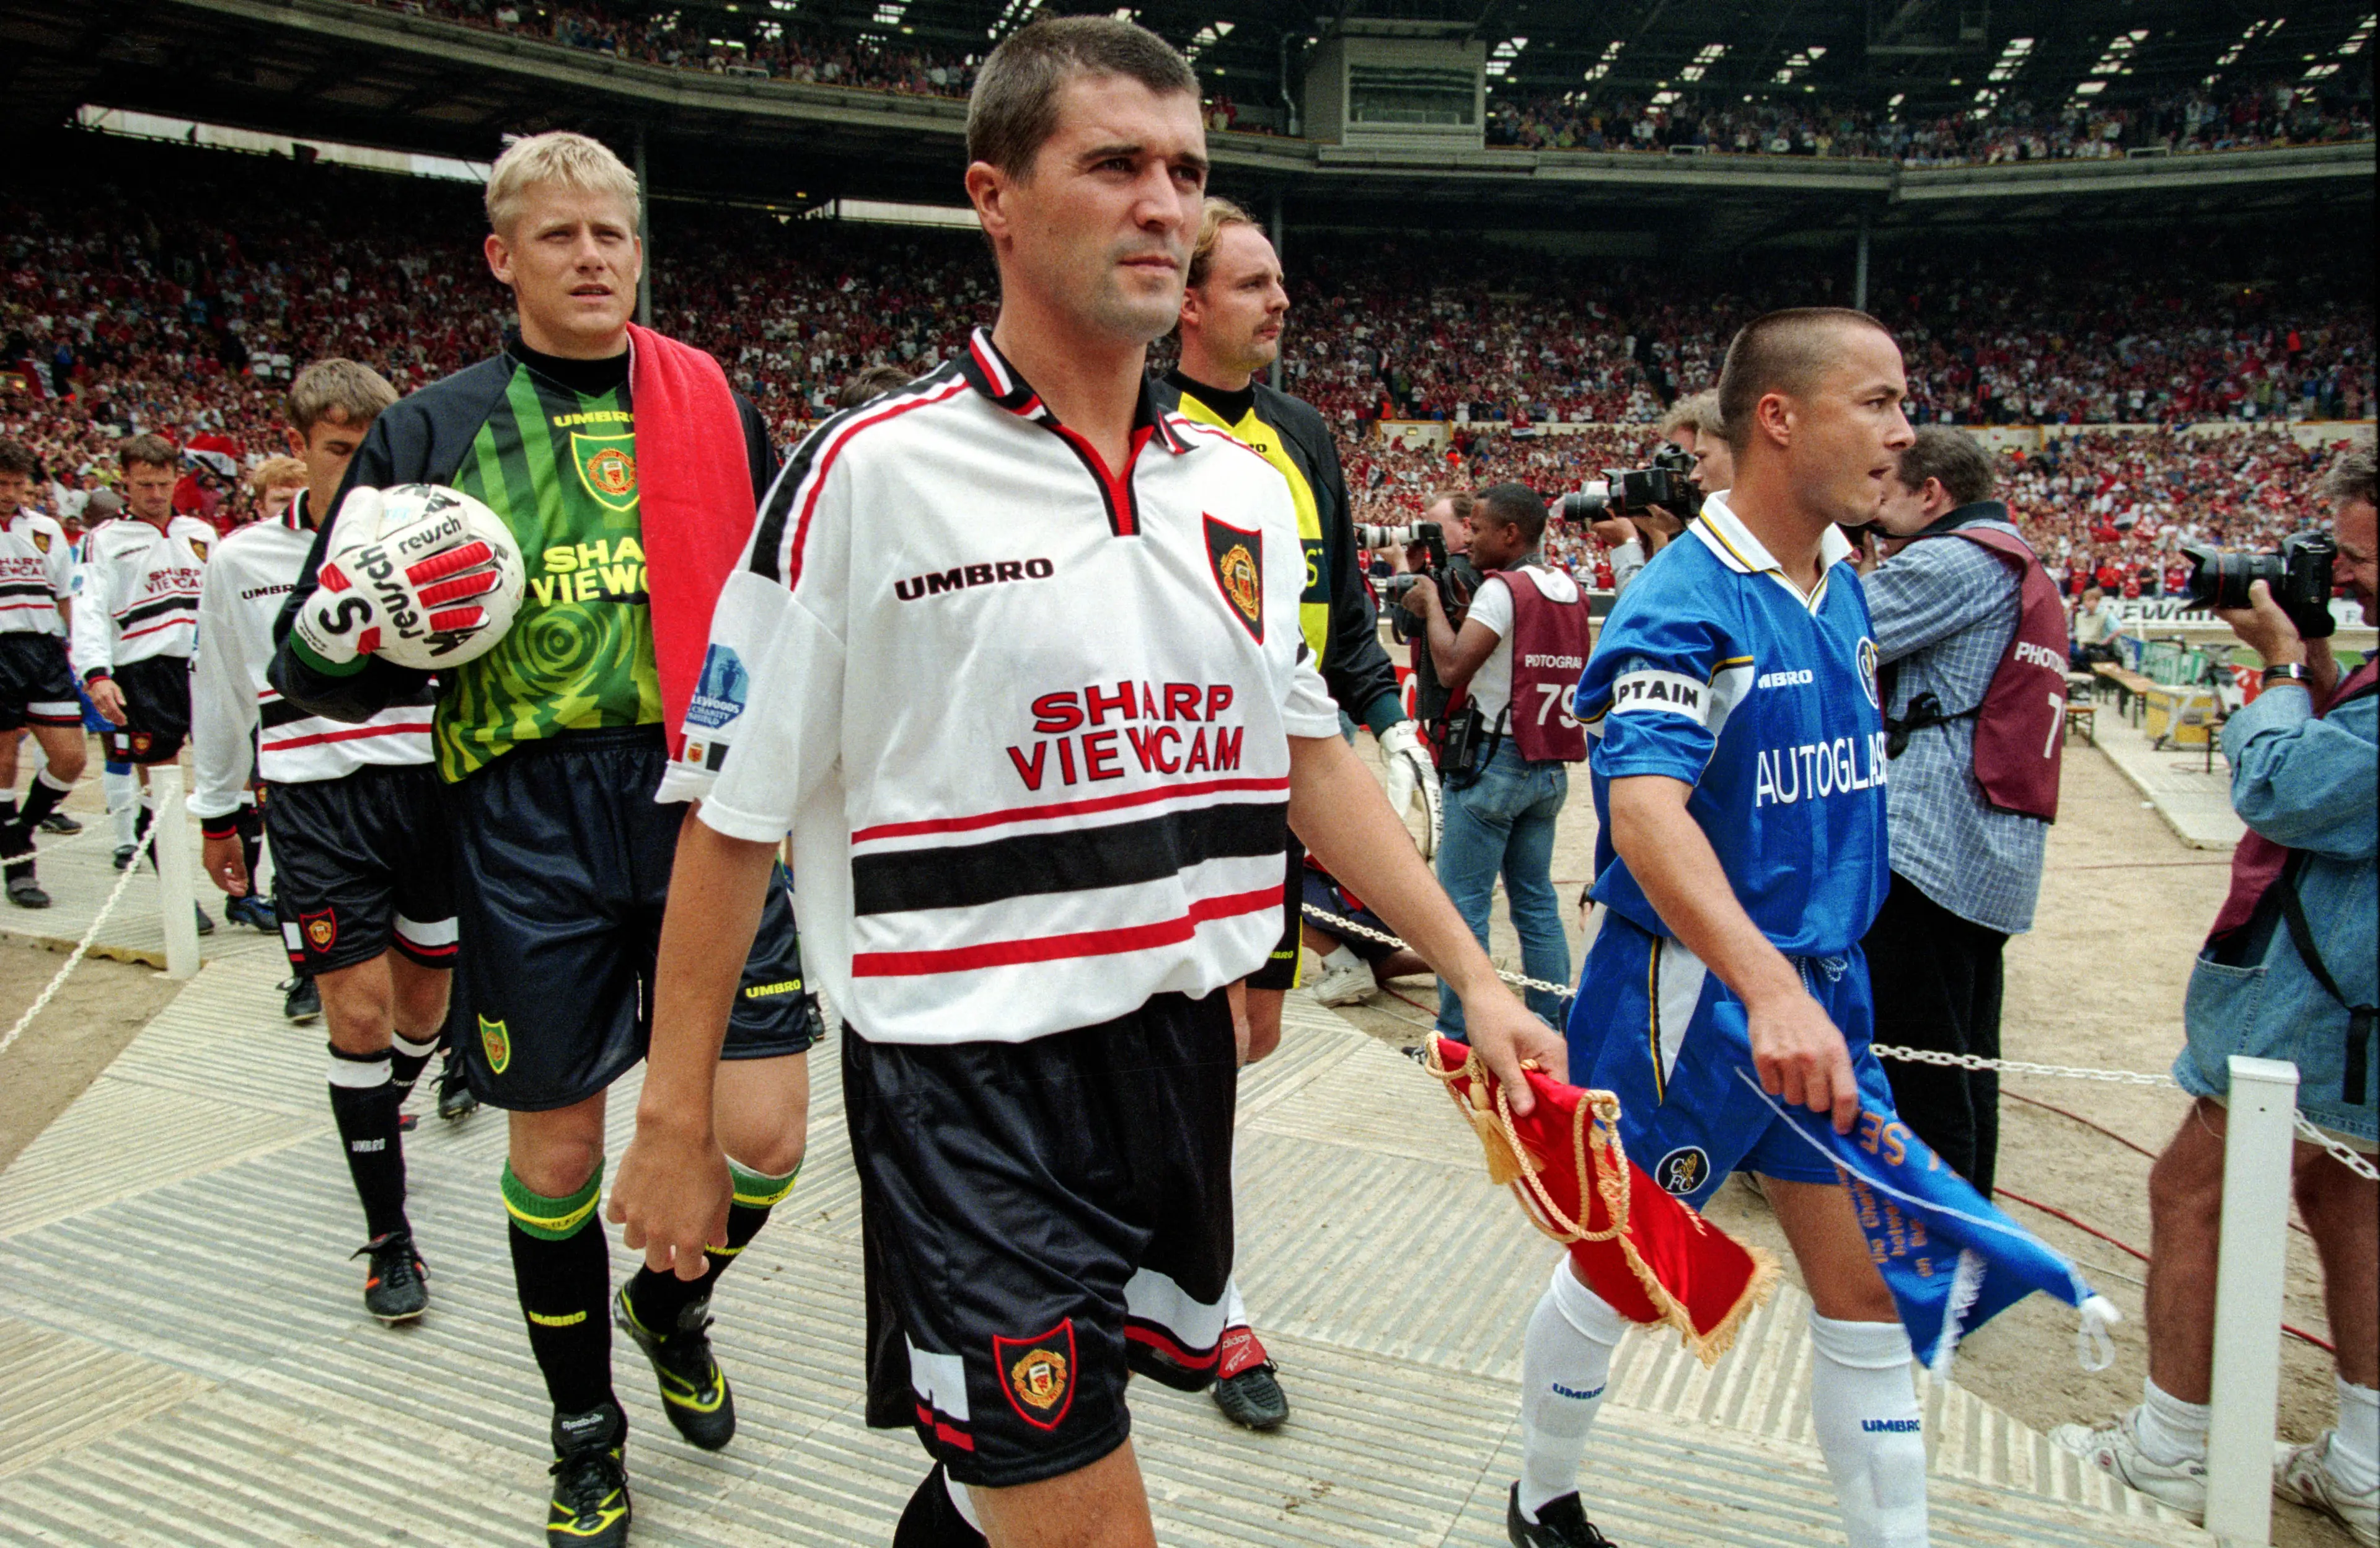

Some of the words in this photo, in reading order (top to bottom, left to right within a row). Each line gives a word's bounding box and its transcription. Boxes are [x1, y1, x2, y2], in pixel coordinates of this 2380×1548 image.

[397, 515, 462, 555] reusch
[354, 544, 426, 640] reusch
[895, 559, 1054, 601] UMBRO
[1031, 680, 1233, 734] SHARP
[1536, 683, 1580, 729] 79
[2043, 692, 2065, 759] 7
[1007, 726, 1243, 791] VIEWCAM
[746, 980, 801, 998] UMBRO
[529, 1310, 587, 1327] UMBRO
